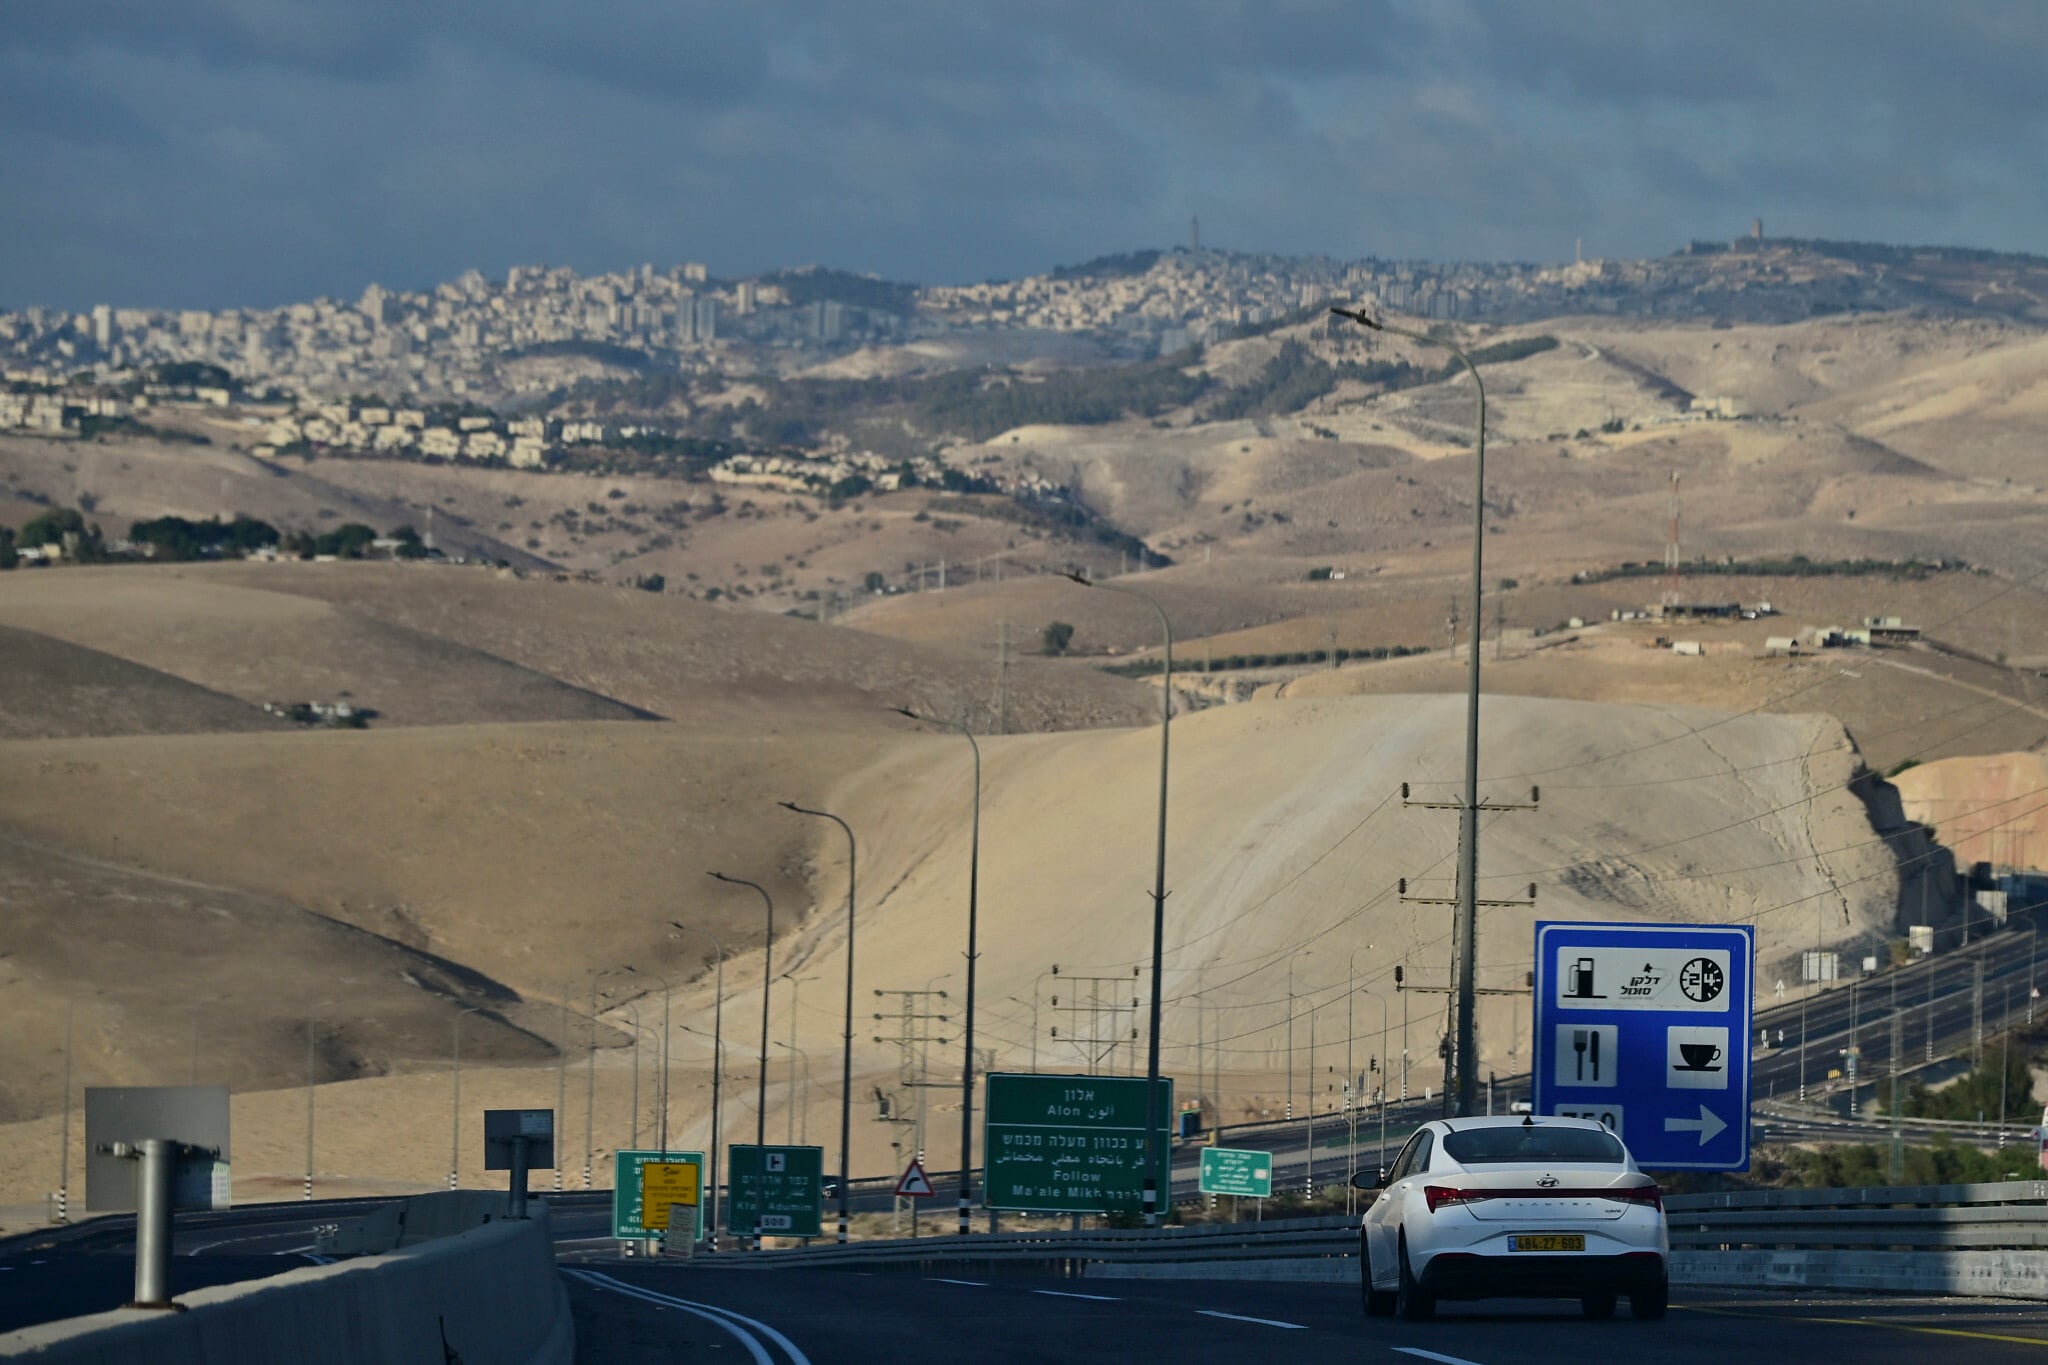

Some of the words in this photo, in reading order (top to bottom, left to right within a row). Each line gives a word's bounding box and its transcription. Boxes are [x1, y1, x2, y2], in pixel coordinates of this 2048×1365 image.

[1630, 975, 1661, 987] דלקן
[1688, 972, 1716, 987] 24
[1064, 1088, 1095, 1102] אלון
[1046, 1104, 1082, 1117] Alon
[1002, 1133, 1042, 1147] מכמש
[1048, 1134, 1087, 1147] מעלה
[1093, 1135, 1128, 1150] בכוון
[1052, 1169, 1102, 1182] Follow
[1012, 1184, 1060, 1197] Ma'ale
